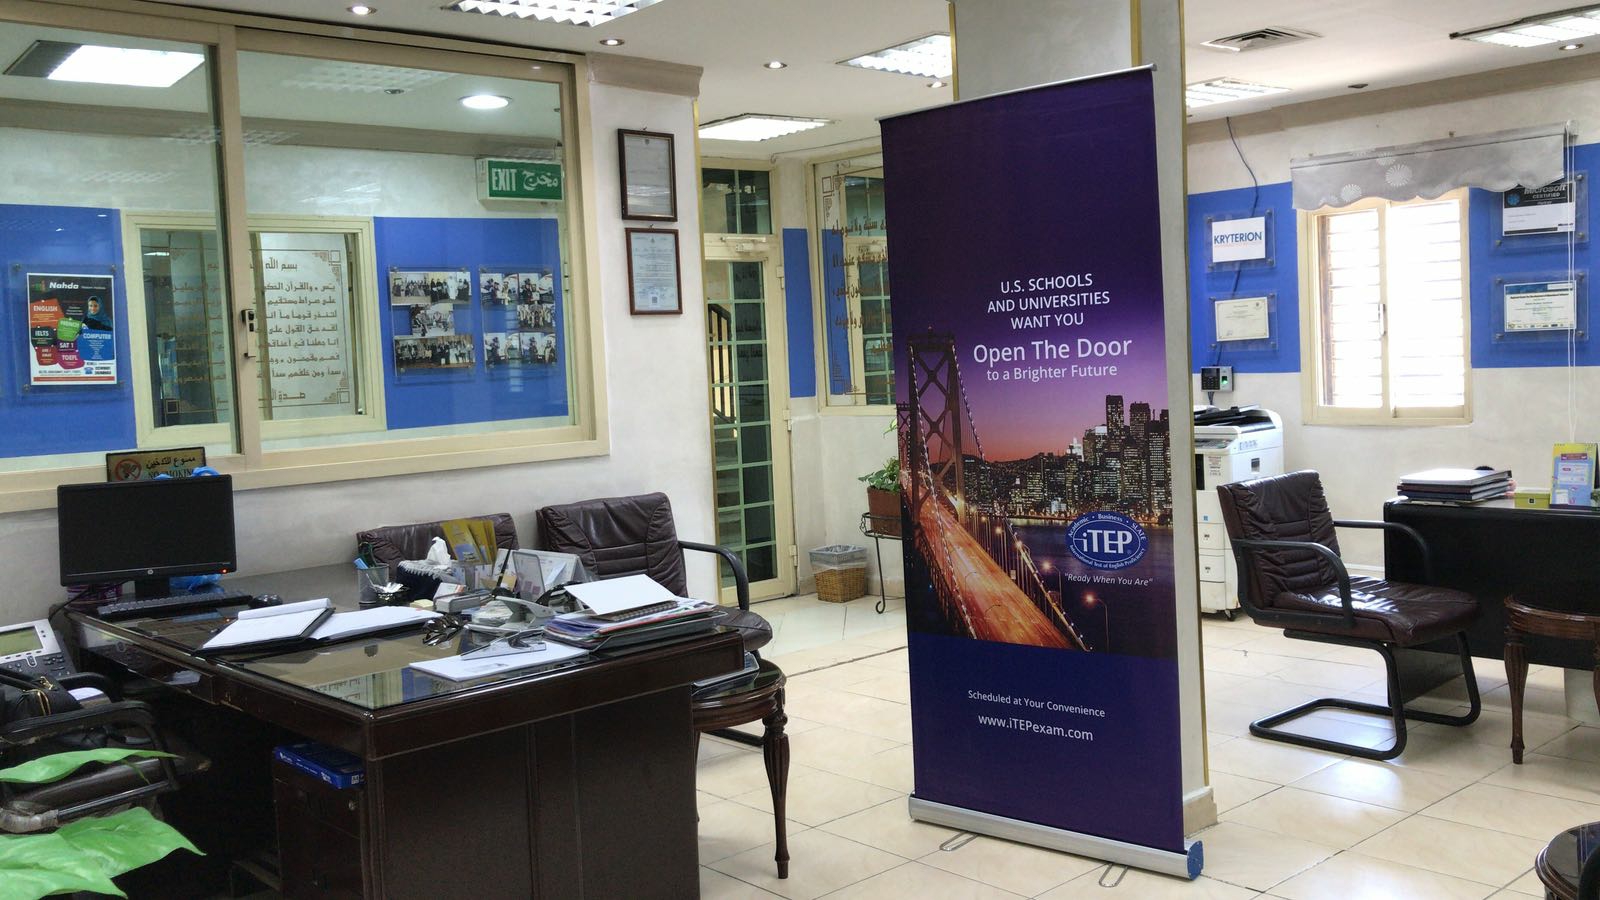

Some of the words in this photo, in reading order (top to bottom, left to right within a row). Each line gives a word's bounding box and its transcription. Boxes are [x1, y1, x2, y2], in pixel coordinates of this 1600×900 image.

[491, 168, 517, 191] EXIT
[522, 170, 559, 191] مخرج
[1213, 231, 1262, 245] KRYTERION
[281, 263, 298, 271] بسم
[1000, 280, 1025, 294] U.S.
[1028, 273, 1093, 291] SCHOOLS
[987, 299, 1015, 313] AND
[1019, 291, 1110, 311] UNIVERSITIES
[1010, 315, 1051, 330] WANT
[1054, 312, 1084, 327] YOU
[973, 344, 1025, 368] Open
[1031, 339, 1070, 360] The
[1077, 338, 1132, 359] Door
[986, 369, 1000, 381] to
[1003, 370, 1010, 380] a
[1013, 366, 1067, 383] Brighter
[1071, 365, 1118, 378] Future
[1068, 517, 1089, 538] Academic
[1098, 513, 1122, 522] Business
[1131, 522, 1146, 540] SLATE
[1082, 529, 1133, 554] iTEP
[1069, 544, 1093, 565] International
[1093, 575, 1115, 584] When
[1117, 576, 1132, 585] You
[967, 689, 1011, 704] Scheduled
[1013, 698, 1022, 706] at
[1023, 698, 1044, 709] Your
[1046, 701, 1105, 718] Convenience
[978, 715, 1093, 741] www.iTEPexam.com
